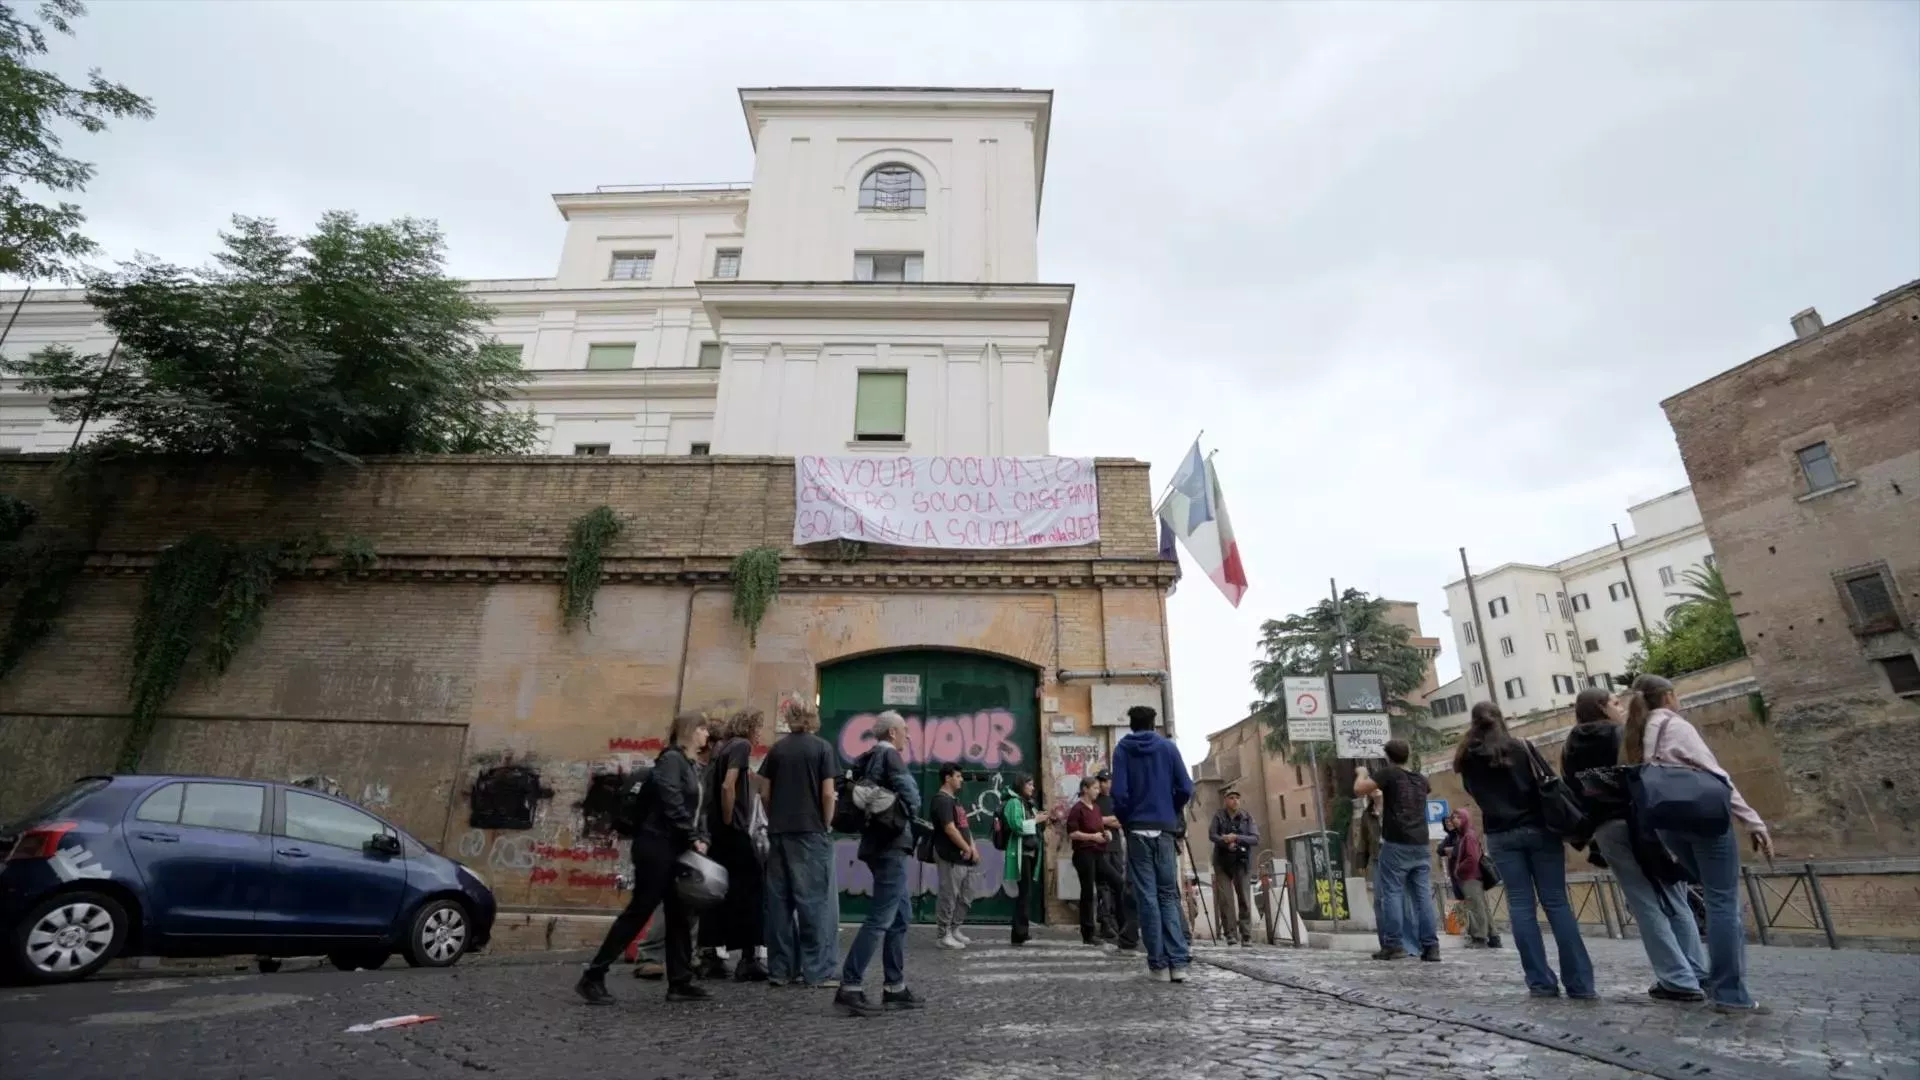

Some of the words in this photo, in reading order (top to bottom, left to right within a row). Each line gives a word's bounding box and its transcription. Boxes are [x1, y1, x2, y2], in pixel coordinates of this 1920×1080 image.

[929, 456, 1080, 487] OCCUPATO
[801, 485, 897, 510] CONTRO
[912, 491, 1005, 514] SCUOLA
[799, 505, 865, 538] SOLDI
[1342, 717, 1383, 727] controllo
[1428, 801, 1444, 821] P
